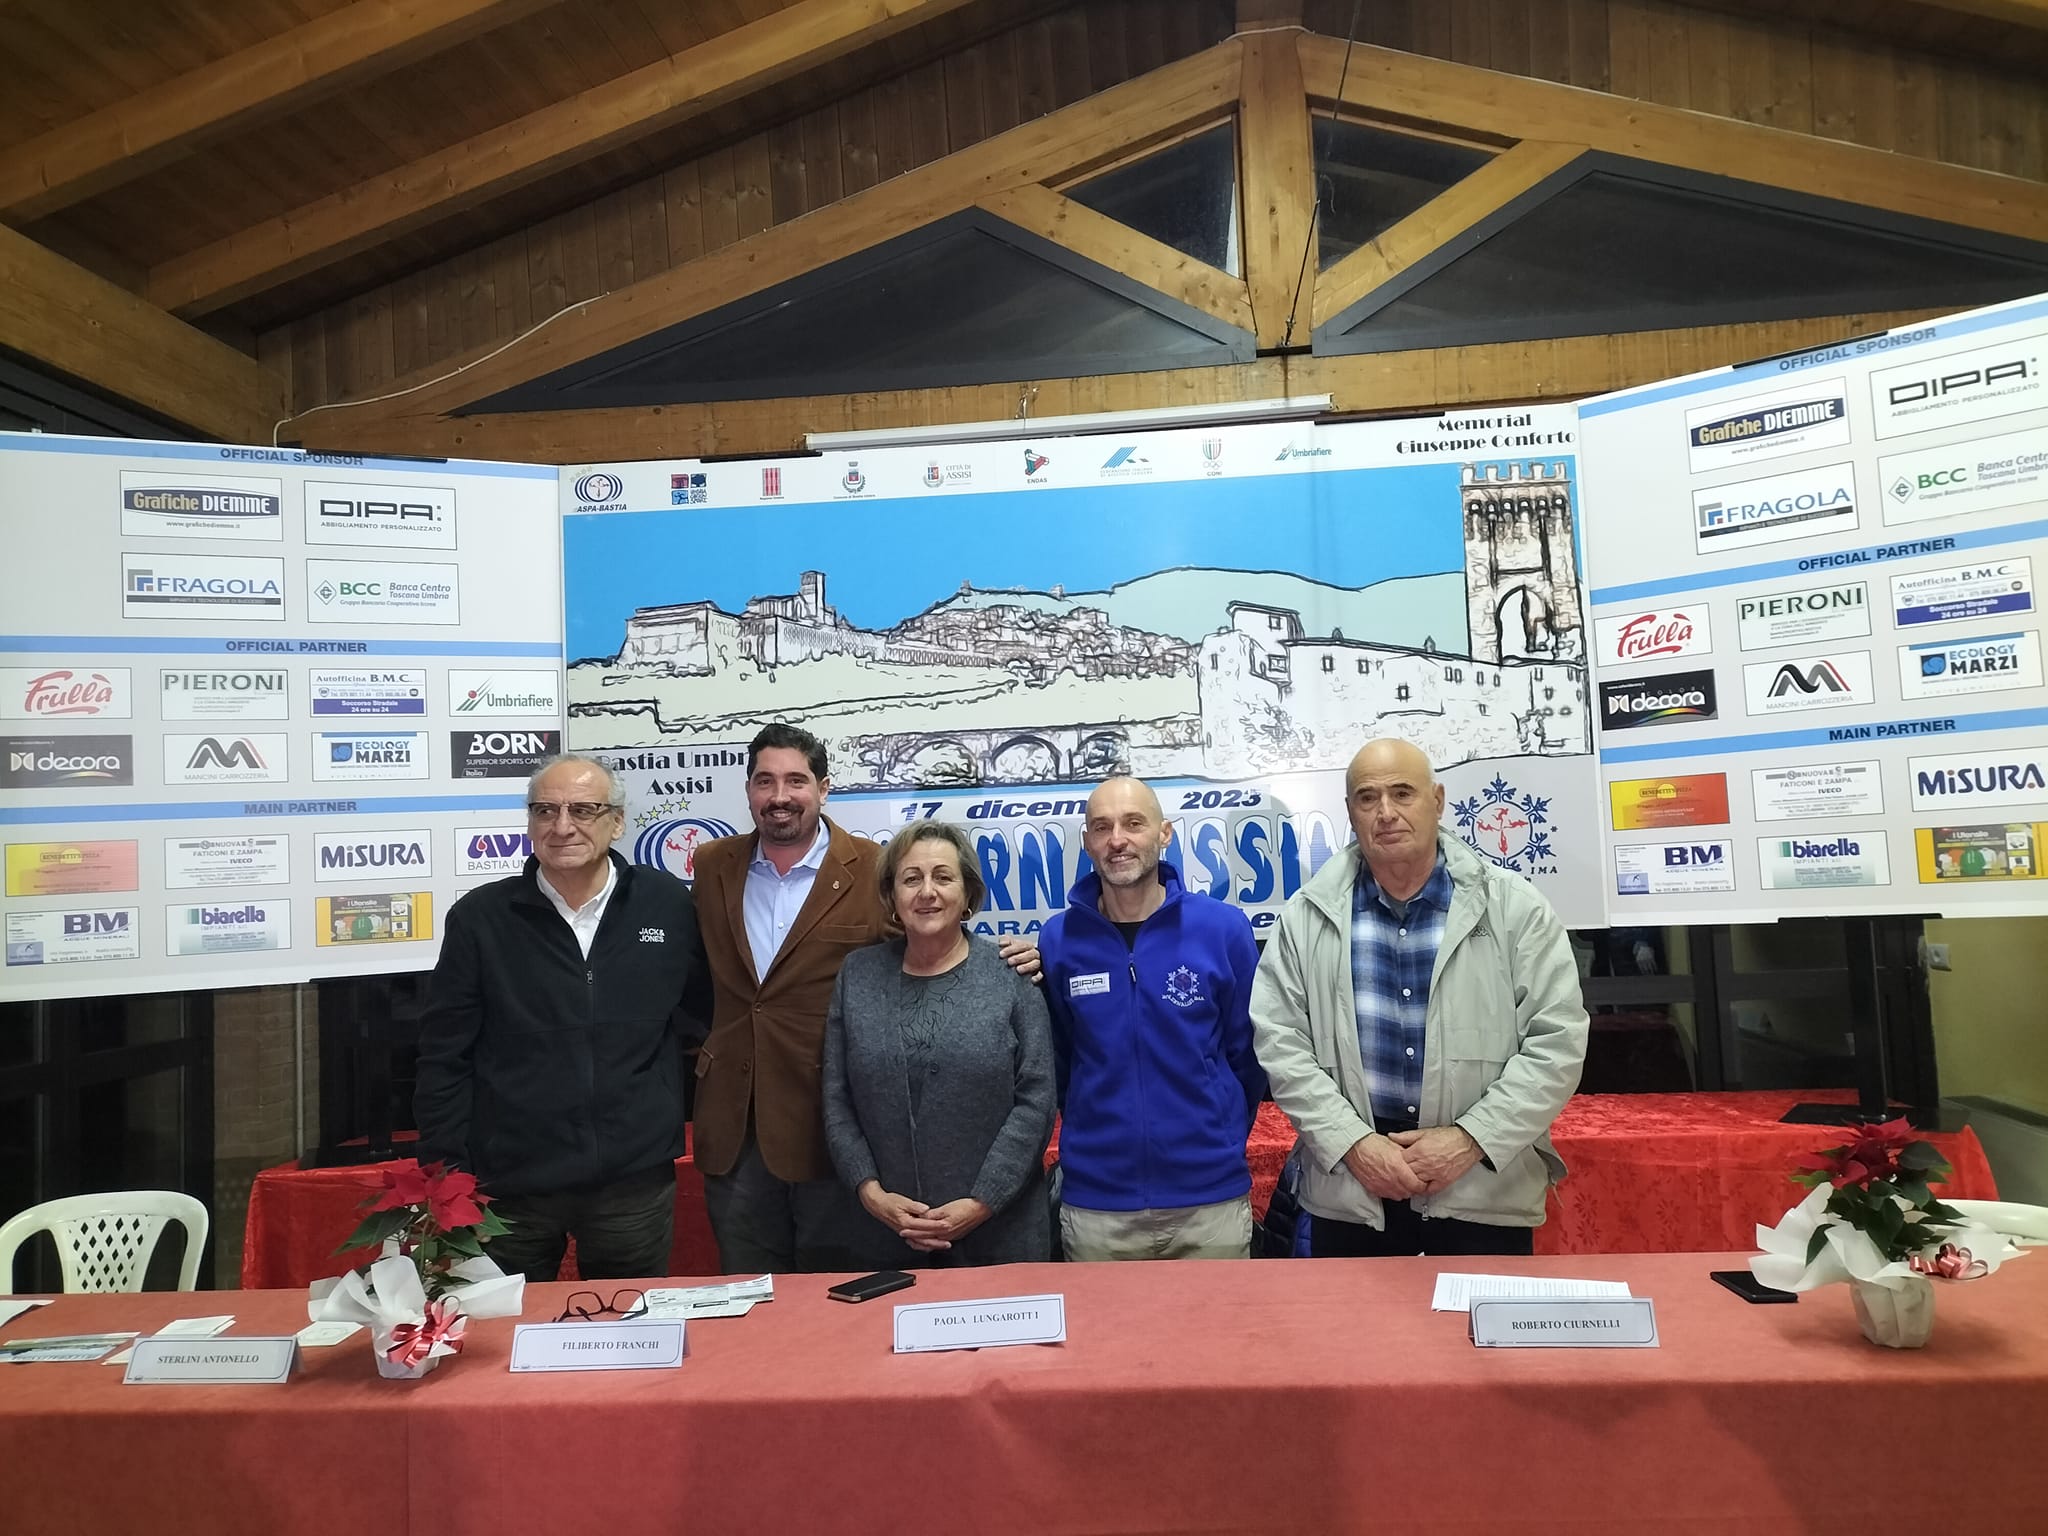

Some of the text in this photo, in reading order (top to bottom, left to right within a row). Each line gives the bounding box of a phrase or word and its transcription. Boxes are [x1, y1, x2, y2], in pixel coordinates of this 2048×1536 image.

[1779, 327, 1936, 370] OFFICIAL SPONSOR
[1892, 383, 2040, 416] ABBIGLIAMENTO PERSONALIZZATO
[1437, 414, 1531, 431] Memorial
[1699, 401, 1836, 444] Grafiche DIEMME
[1396, 431, 1576, 454] Giuseppe Conforto
[220, 448, 363, 465] OFFICIAL SPONSOR
[1292, 447, 1332, 458] Umbriafiere
[1977, 453, 2048, 472] Banca Centr
[946, 471, 971, 479] ASSISI
[1918, 468, 1967, 489] BCC
[1978, 464, 2048, 481] Toscana Umbri
[133, 491, 271, 514] Grafiche DIEMME
[577, 504, 627, 513] ASPA-BASTIA
[1727, 488, 1851, 522] FRAGOLA
[321, 521, 442, 532] ABBIGLIAMENTO PERSONALIZZATO
[1799, 538, 1956, 570] OFFICIAL PARTNER
[157, 577, 280, 595] FRAGOLA
[339, 582, 381, 596] BCC
[389, 582, 451, 593] Banca Centro
[1899, 576, 1956, 589] Autofficina
[389, 591, 449, 600] Toscana Umbria
[1741, 588, 1861, 620] PIERONI
[1617, 613, 1693, 658] Frullà
[226, 641, 367, 652] OFFICIAL PARTNER
[1950, 644, 2015, 659] ECOLOGY
[1951, 655, 2018, 675] MARZI
[164, 675, 283, 690] PIERONI
[316, 675, 366, 683] Autofficina
[24, 671, 113, 714] Frullà
[487, 693, 553, 707] Umbriafiere
[1631, 691, 1705, 711] decora
[1829, 720, 1956, 740] MAIN PARTNER
[355, 741, 410, 750] ECOLOGY
[37, 752, 120, 770] decora
[355, 751, 411, 763] MARZI
[677, 750, 749, 768] Umbr
[647, 776, 712, 795] Assisi
[1780, 780, 1816, 788] FATICONI
[244, 802, 357, 814] MAIN PARTNER
[901, 790, 1261, 820] 17 dicem 2023
[467, 834, 533, 859] AVI
[1792, 838, 1860, 858] biarella
[1664, 845, 1724, 867] BM
[468, 861, 509, 870] BASTIA
[64, 912, 129, 934] BM
[201, 905, 266, 925] biarella
[934, 1316, 966, 1326] PAOLA
[1512, 1319, 1621, 1330] ROBERTO CIURNELLI
[562, 1340, 660, 1350] FILIBERTO FRANCHI
[157, 1354, 259, 1364] STERLINI ANTONELLO
